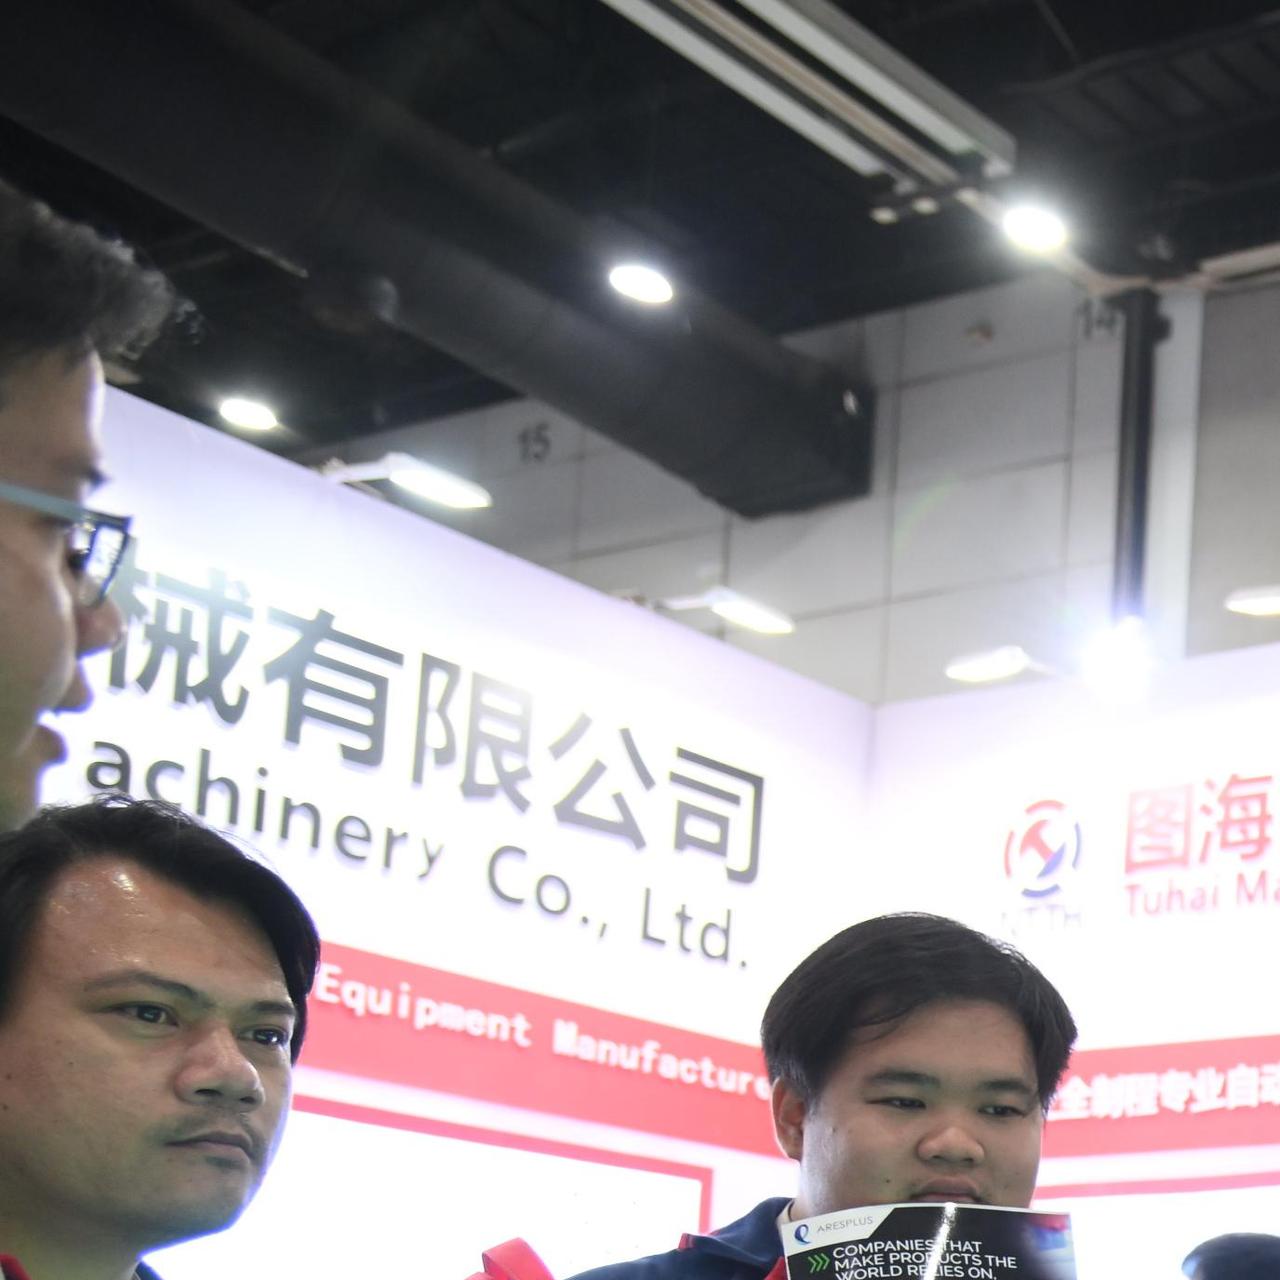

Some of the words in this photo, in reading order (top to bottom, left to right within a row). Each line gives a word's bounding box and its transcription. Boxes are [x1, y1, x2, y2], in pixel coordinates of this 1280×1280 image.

[86, 740, 446, 880] achinery
[487, 844, 607, 939] Co.,
[640, 888, 750, 969] Ltd.
[1124, 877, 1220, 918] Tuhai
[315, 961, 533, 1048] Equipment
[553, 1018, 774, 1101] Manufacture
[816, 1215, 874, 1234] ARESPLUS
[832, 1239, 935, 1259] COMPANIES
[835, 1253, 885, 1272] MAKE
[985, 1254, 1018, 1269] THE
[908, 1265, 964, 1280] REIES
